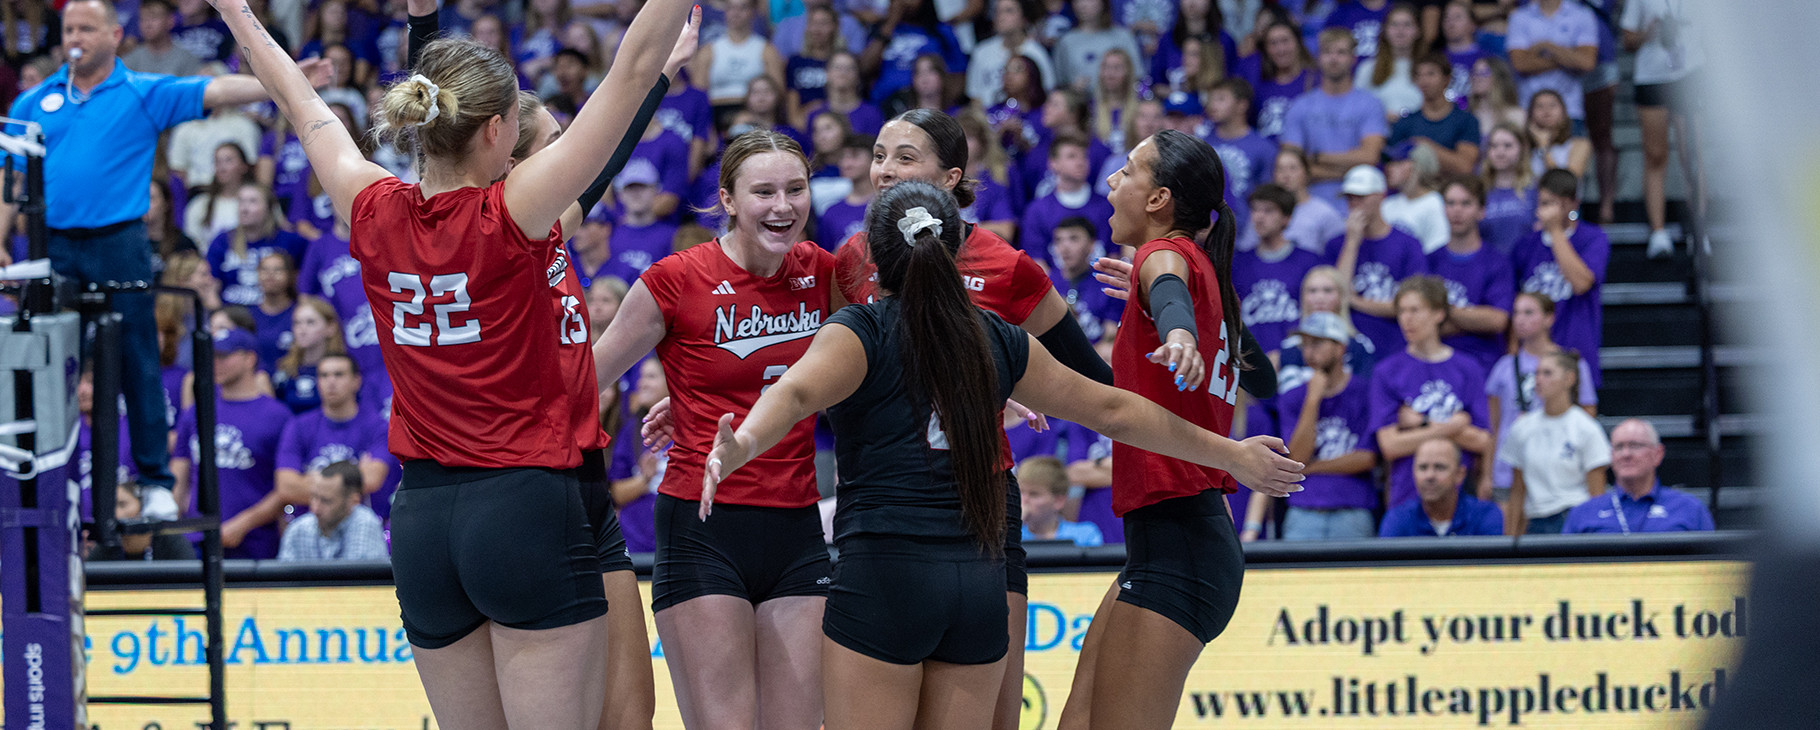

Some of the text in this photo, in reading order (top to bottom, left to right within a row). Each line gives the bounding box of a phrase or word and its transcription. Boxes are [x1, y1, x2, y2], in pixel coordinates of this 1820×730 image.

[387, 271, 482, 346] 22
[560, 295, 588, 345] 15
[714, 301, 822, 344] Nebraska
[111, 616, 209, 675] 9th
[224, 616, 414, 662] Annua
[1025, 603, 1094, 652] Da
[1268, 596, 1747, 655] Adopt your duck tod
[24, 642, 45, 730] sports im
[1190, 668, 1727, 726] www.littleappleduckd
